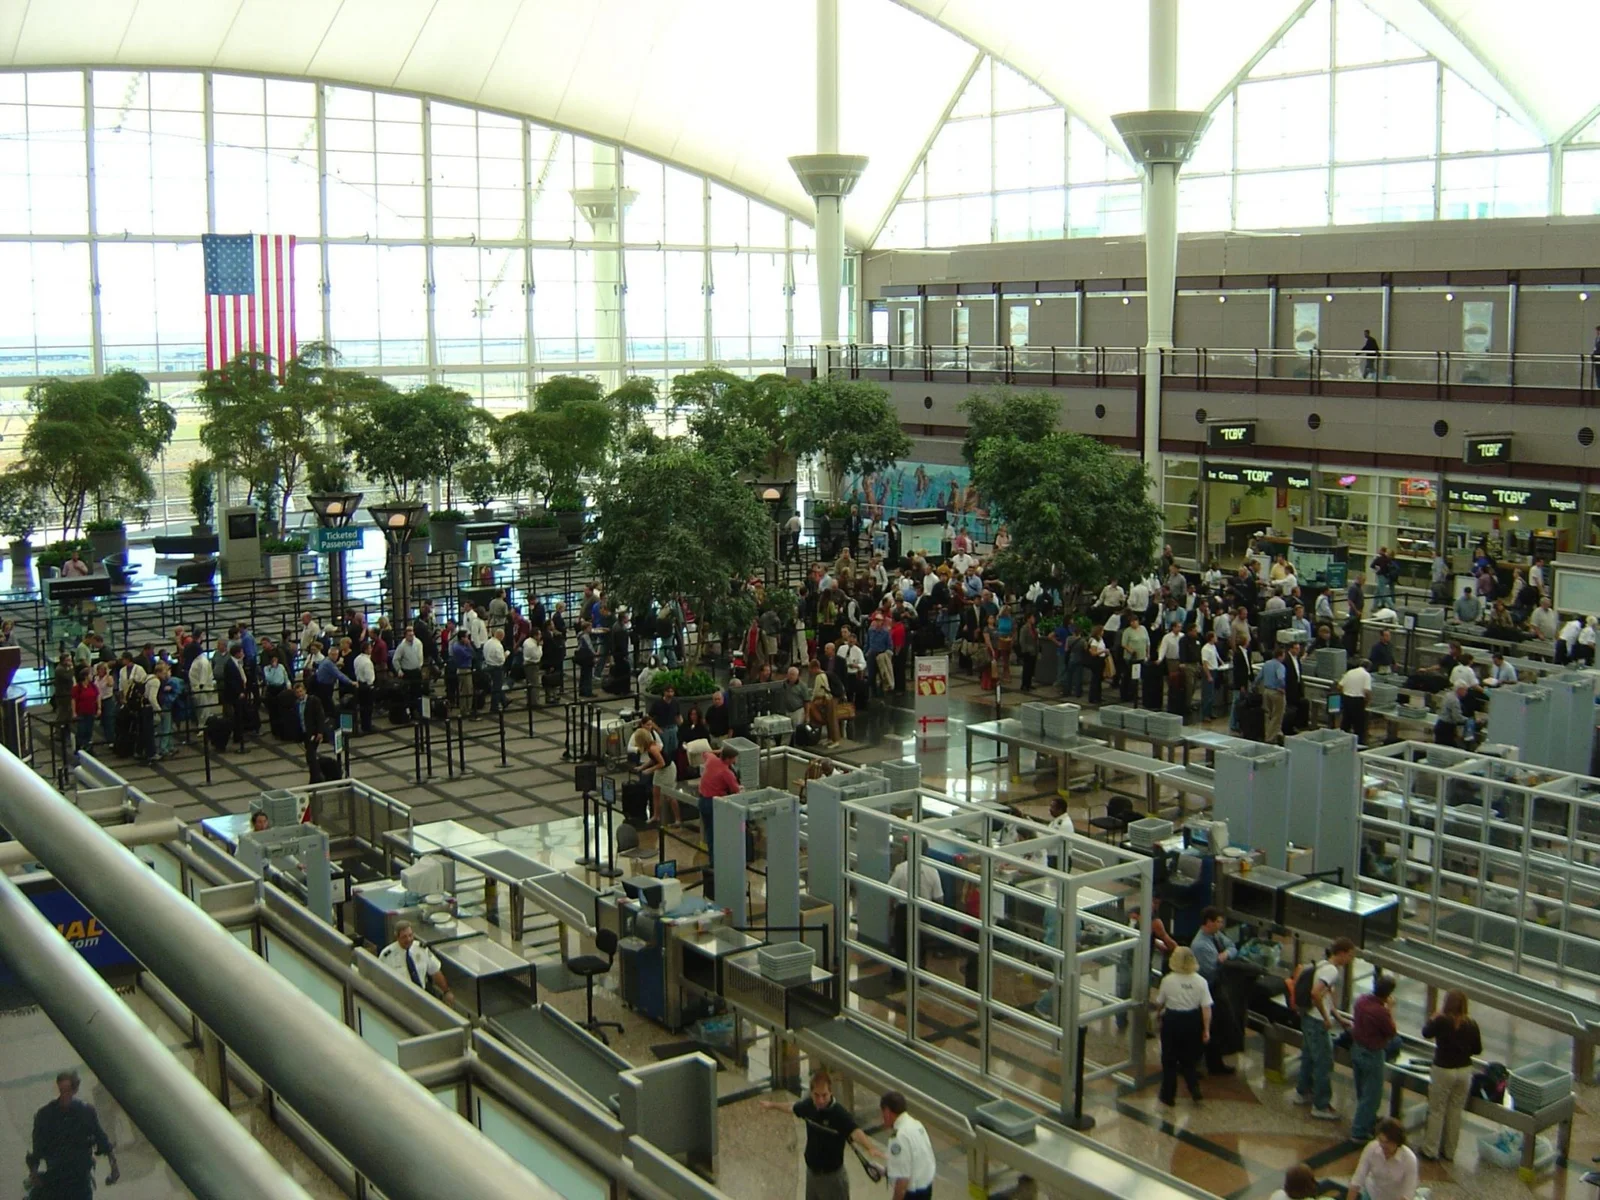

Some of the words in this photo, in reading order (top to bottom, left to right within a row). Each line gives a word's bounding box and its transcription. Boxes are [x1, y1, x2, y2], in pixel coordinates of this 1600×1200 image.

[1219, 471, 1239, 480] Cream
[1288, 477, 1309, 488] Yogurt
[1462, 491, 1487, 502] Cream
[1550, 499, 1577, 511] Yogurt
[326, 531, 358, 539] Ticketed
[321, 540, 362, 549] Passengers
